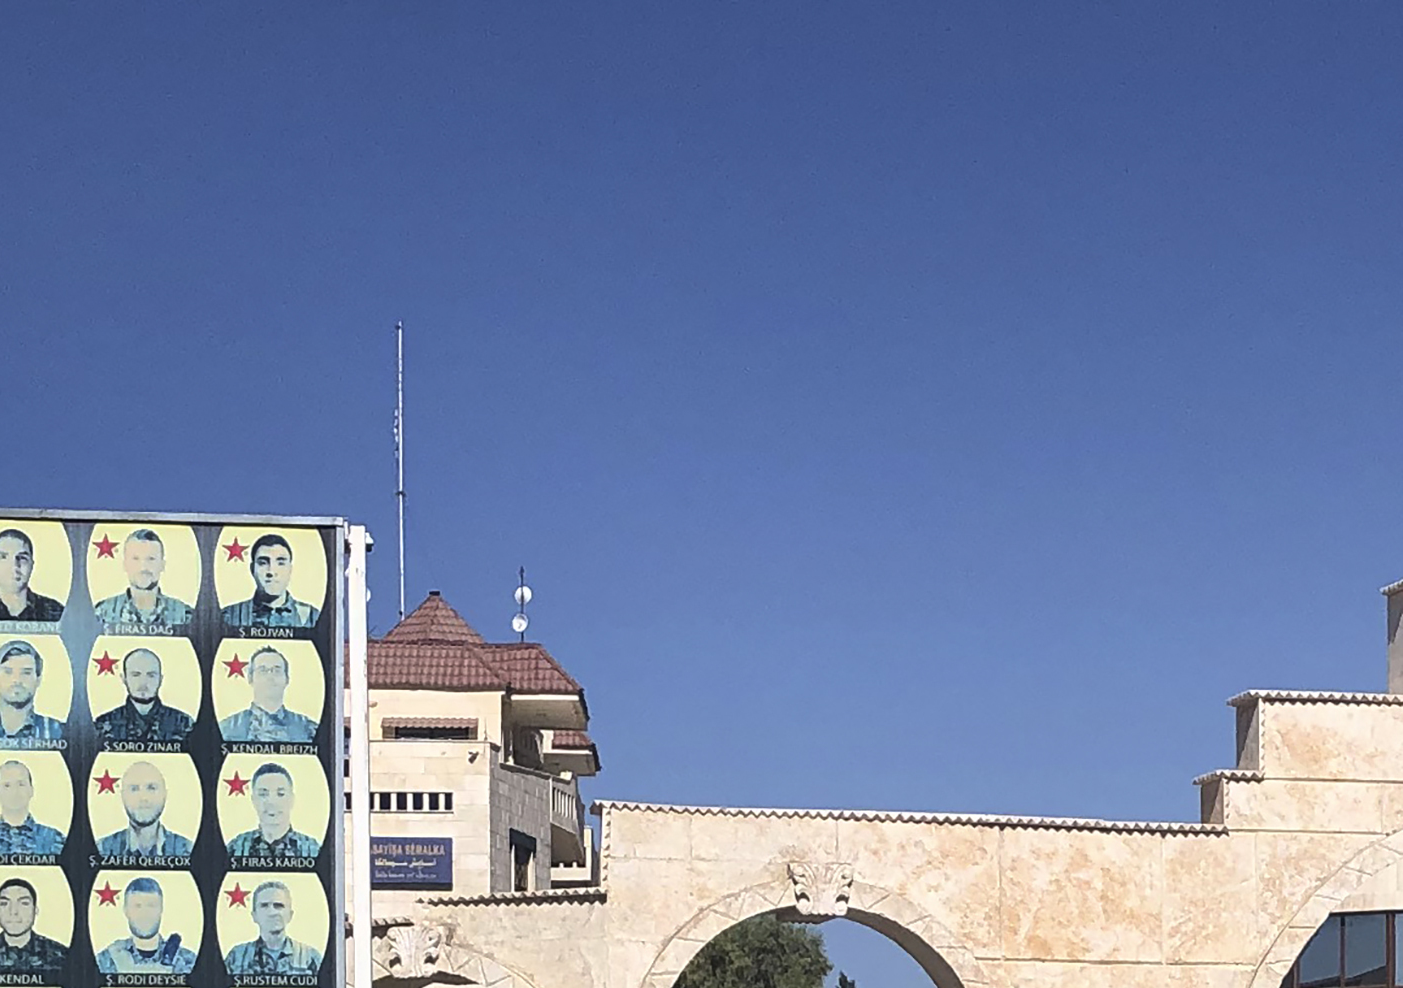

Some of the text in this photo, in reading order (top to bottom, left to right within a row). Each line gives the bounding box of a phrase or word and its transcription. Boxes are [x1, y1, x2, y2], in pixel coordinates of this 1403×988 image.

[232, 744, 278, 755] KENDAL
[280, 745, 318, 755] BREIZH
[242, 857, 273, 868] FIRAS
[275, 857, 315, 868] KARDO
[0, 974, 45, 985] KENDAL
[118, 974, 146, 985] RODI
[290, 976, 318, 987] CUDI
